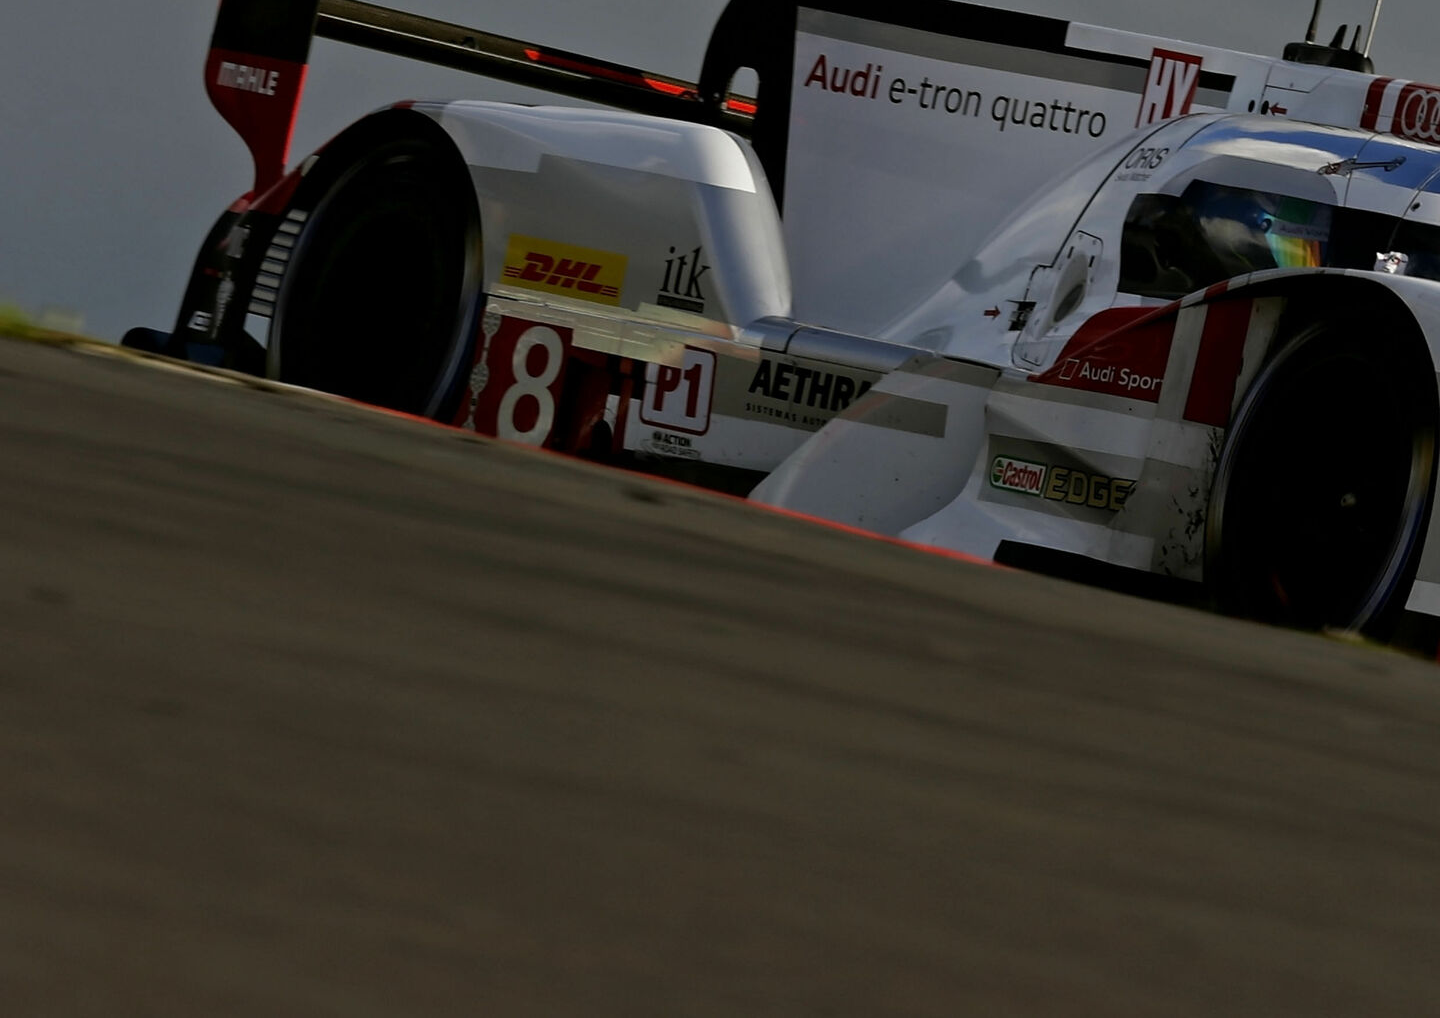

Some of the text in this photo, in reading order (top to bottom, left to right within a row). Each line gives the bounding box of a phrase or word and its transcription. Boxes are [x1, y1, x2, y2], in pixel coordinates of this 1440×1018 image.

[803, 53, 1107, 138] Audi e-tron quattro
[1125, 147, 1170, 169] ORIS
[518, 252, 604, 290] DHL
[659, 245, 711, 301] itk
[497, 325, 564, 448] 8
[652, 363, 702, 419] P1
[1078, 361, 1164, 391] Audi Spor
[1001, 461, 1138, 512] Castrol EDGE
